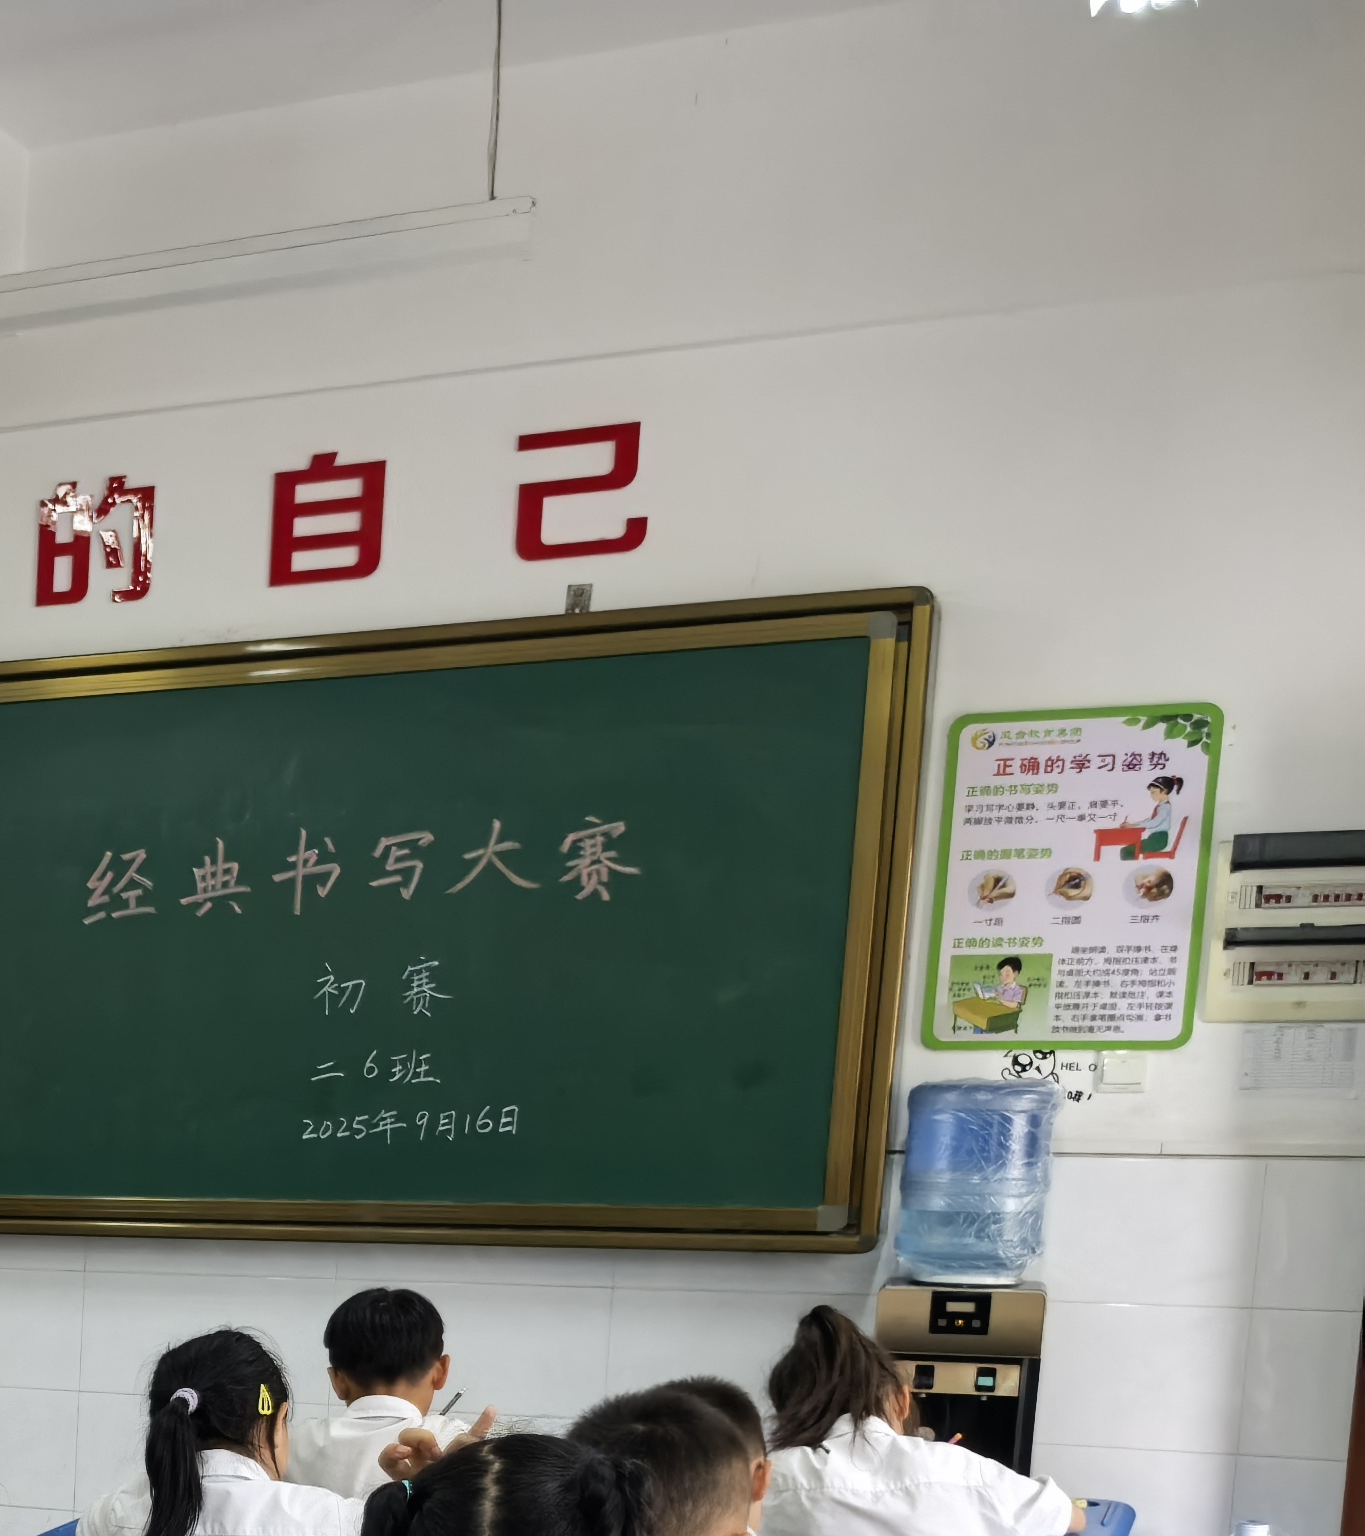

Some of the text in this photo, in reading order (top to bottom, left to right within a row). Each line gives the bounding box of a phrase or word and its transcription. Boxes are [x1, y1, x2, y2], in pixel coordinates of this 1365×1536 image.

[993, 750, 1170, 777] 正确的学习姿势
[966, 783, 1059, 798] 正确的书写姿势
[81, 816, 642, 925] 经典书写大赛
[960, 848, 1053, 862] 正确的握笔姿势
[952, 935, 1045, 950] 正确的读书姿势
[313, 956, 454, 1017] 初赛
[310, 1048, 441, 1086] 二6班
[301, 1103, 520, 1144] 2025年9月16日
